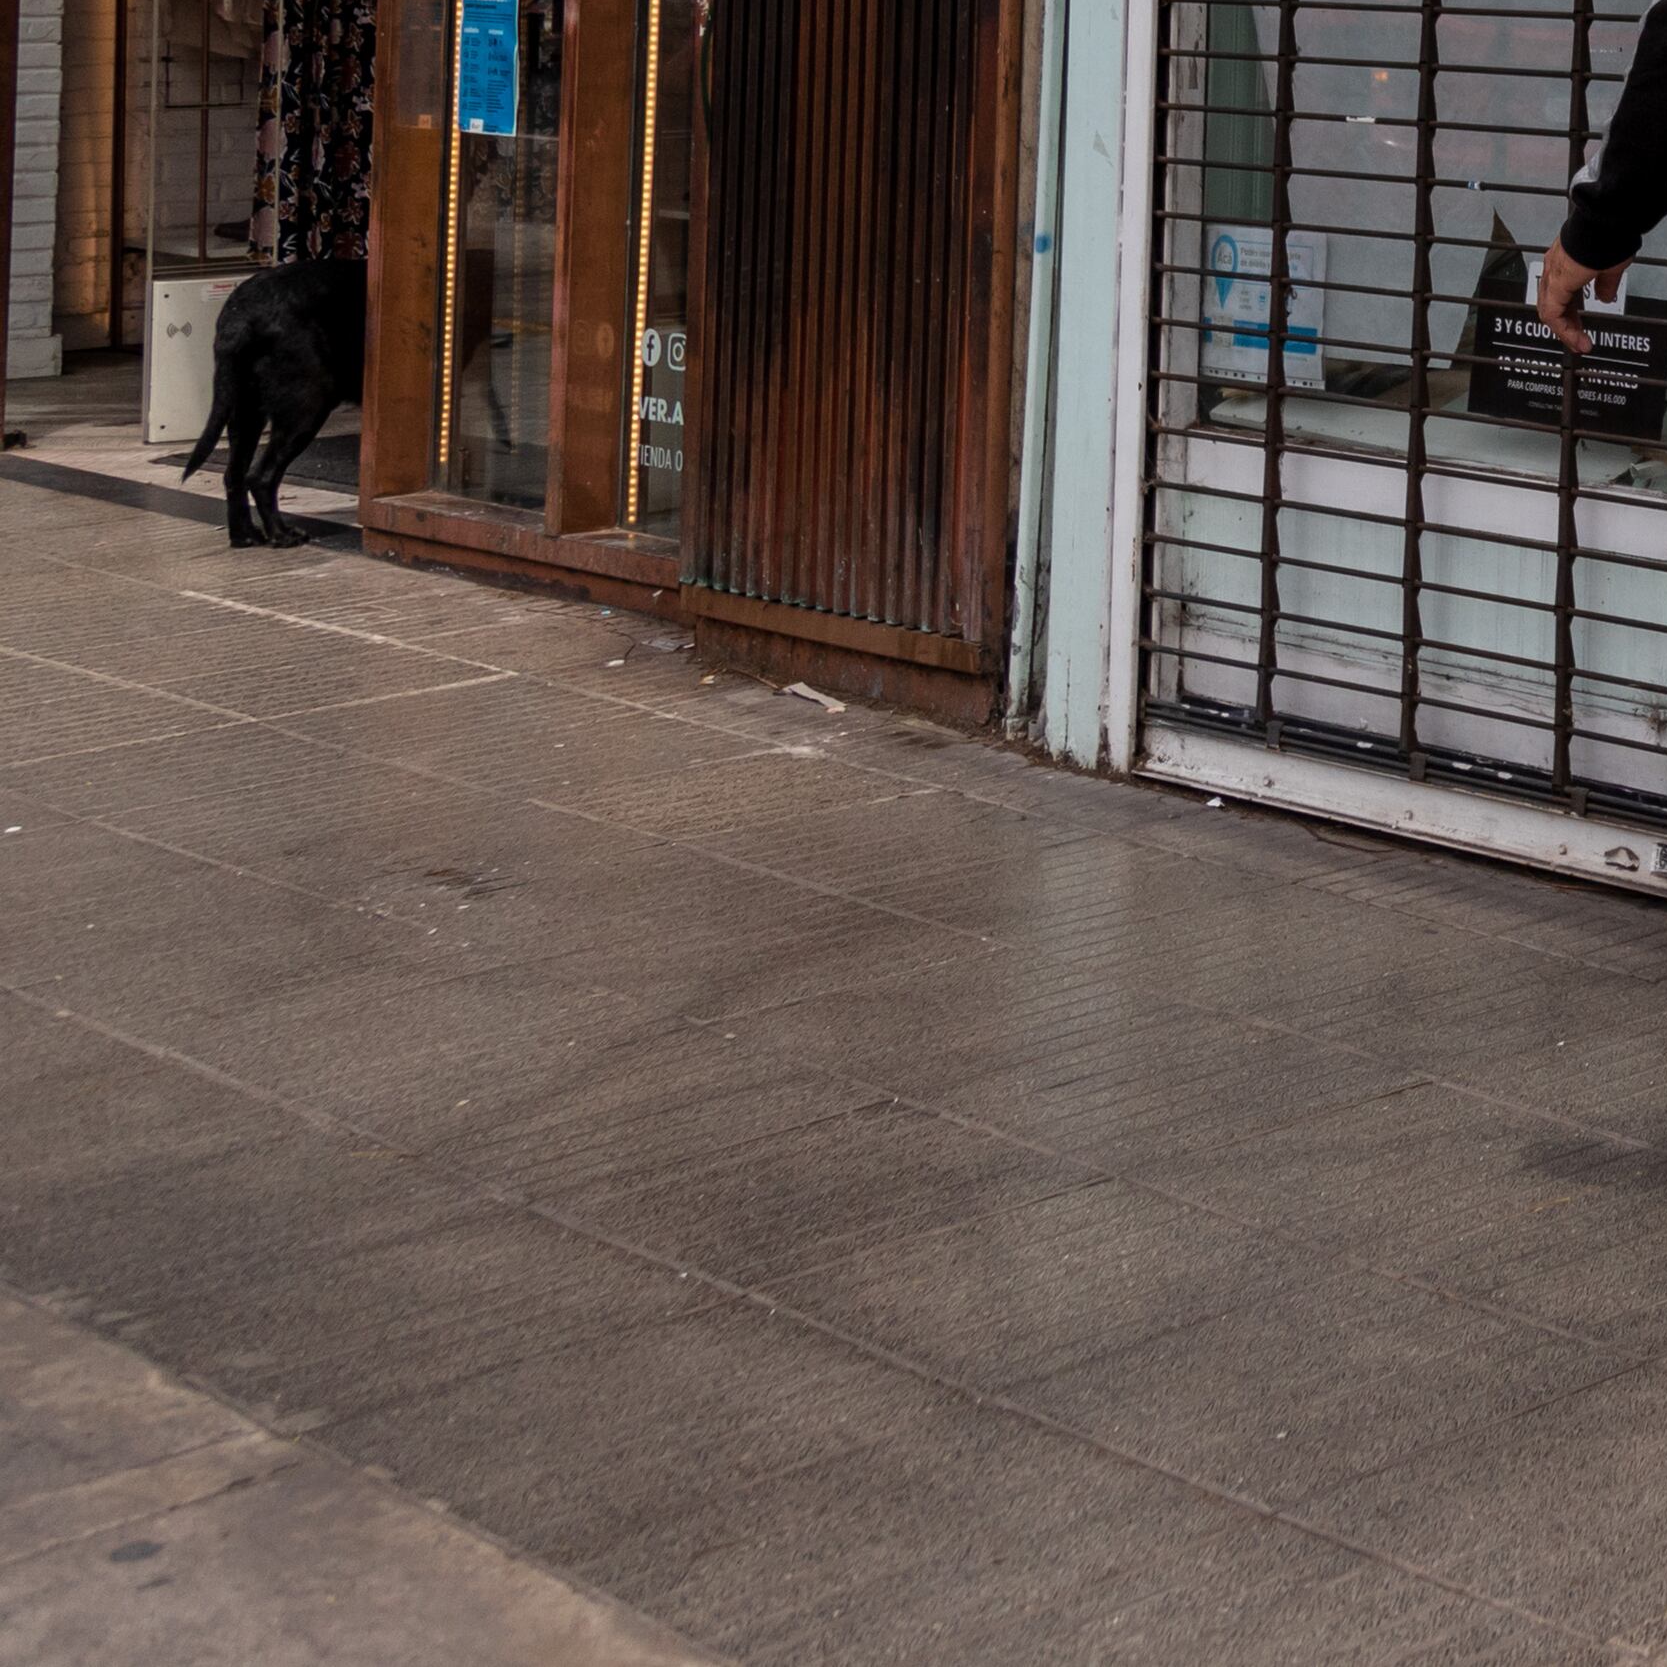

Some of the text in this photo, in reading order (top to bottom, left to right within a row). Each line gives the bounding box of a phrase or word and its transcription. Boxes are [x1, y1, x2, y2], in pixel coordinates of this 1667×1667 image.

[1494, 317, 1502, 333] 3
[1505, 318, 1513, 334] Y
[1515, 320, 1522, 335] 6
[1600, 332, 1651, 352] INTERES
[1507, 379, 1524, 391] PARA
[1525, 381, 1555, 396] COMPRAS
[1555, 385, 1597, 400] SUORES
